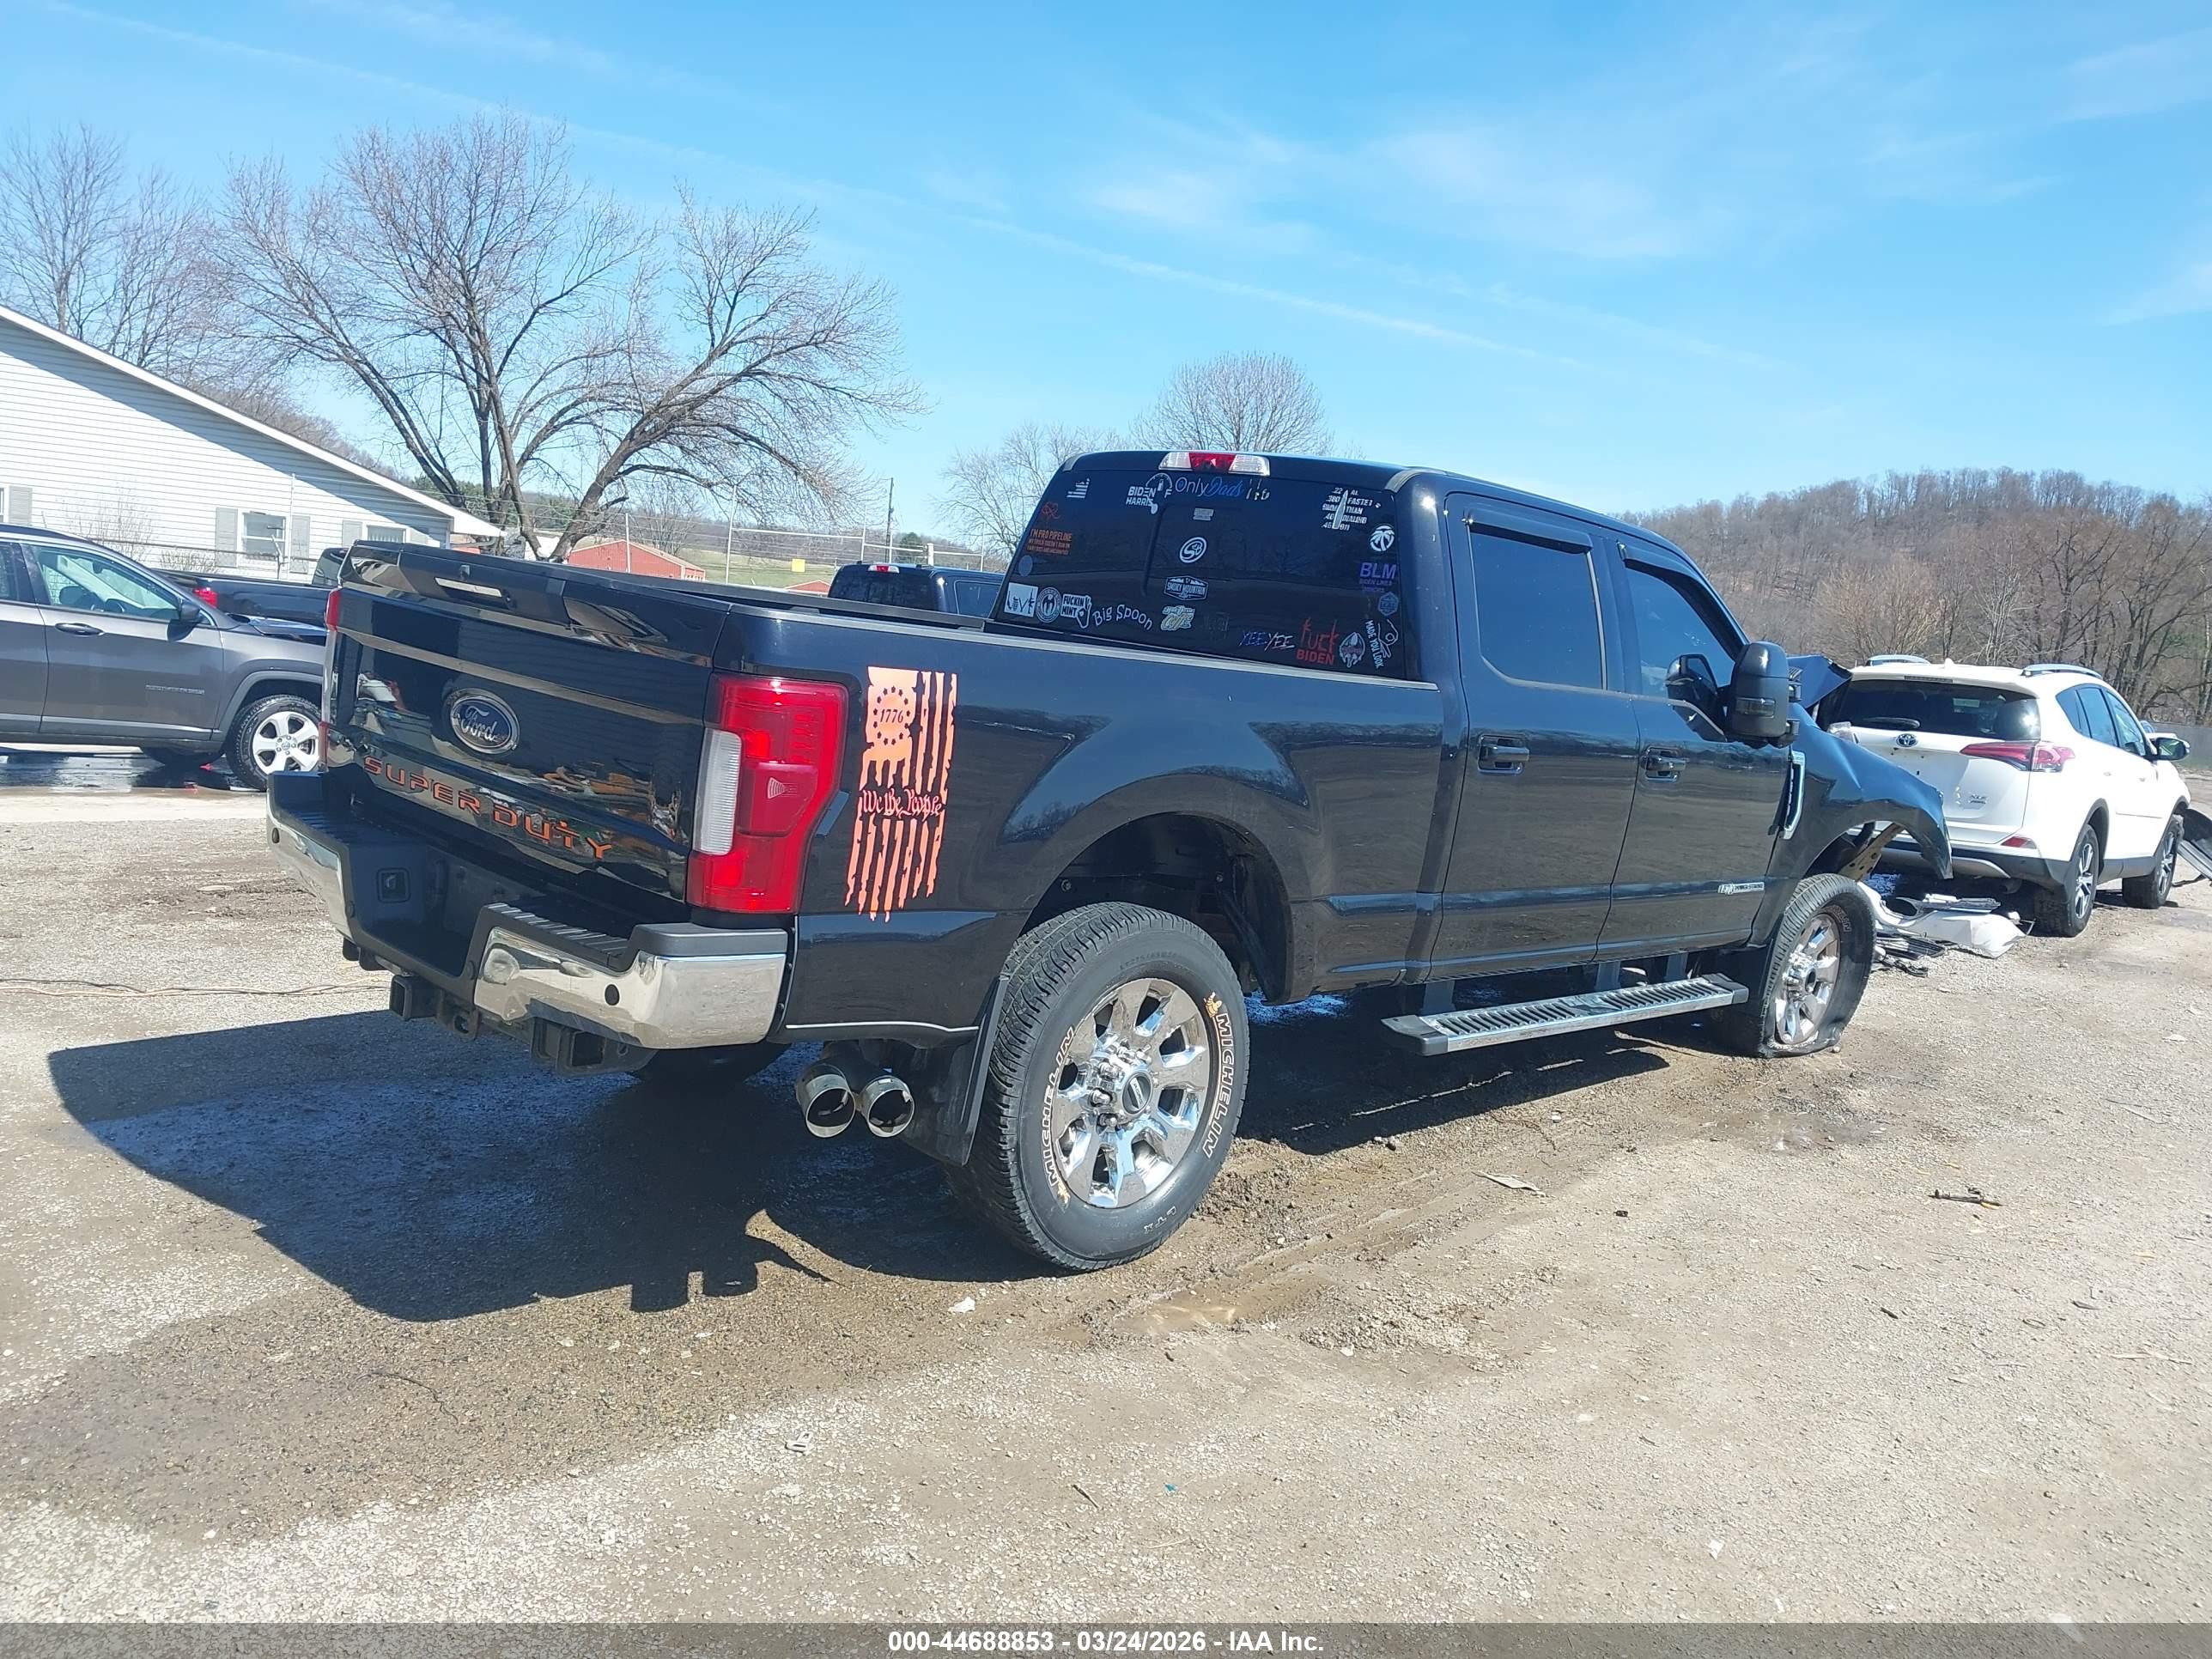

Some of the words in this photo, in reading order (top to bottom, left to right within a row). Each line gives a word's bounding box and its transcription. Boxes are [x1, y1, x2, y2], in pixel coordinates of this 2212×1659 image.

[1127, 486, 1157, 498] BIDEN
[1126, 496, 1154, 507] HARRIS
[1038, 529, 1049, 538] PRO
[1049, 531, 1073, 542] PIPELINE
[1360, 562, 1397, 580] BLM
[1167, 581, 1182, 592] SMOKY
[1182, 584, 1206, 595] MOUNTAIN
[1064, 595, 1085, 607] FUCKIN
[1061, 605, 1077, 617] MINT
[1092, 606, 1113, 627] Big
[1115, 604, 1153, 630] Spoon
[1365, 620, 1376, 638] MADE
[1369, 638, 1380, 653] YOU
[1297, 648, 1335, 665] BIDEN
[1372, 651, 1384, 669] LOOK
[460, 703, 502, 742] Ford
[879, 708, 904, 723] 1776
[363, 755, 482, 815] SUPER
[492, 804, 612, 860] DUTY
[861, 788, 883, 814] We
[882, 787, 902, 816] the
[900, 787, 943, 819] People
[1202, 1012, 1235, 1158] MICHELIN
[1040, 1026, 1074, 1187] MICHELIN
